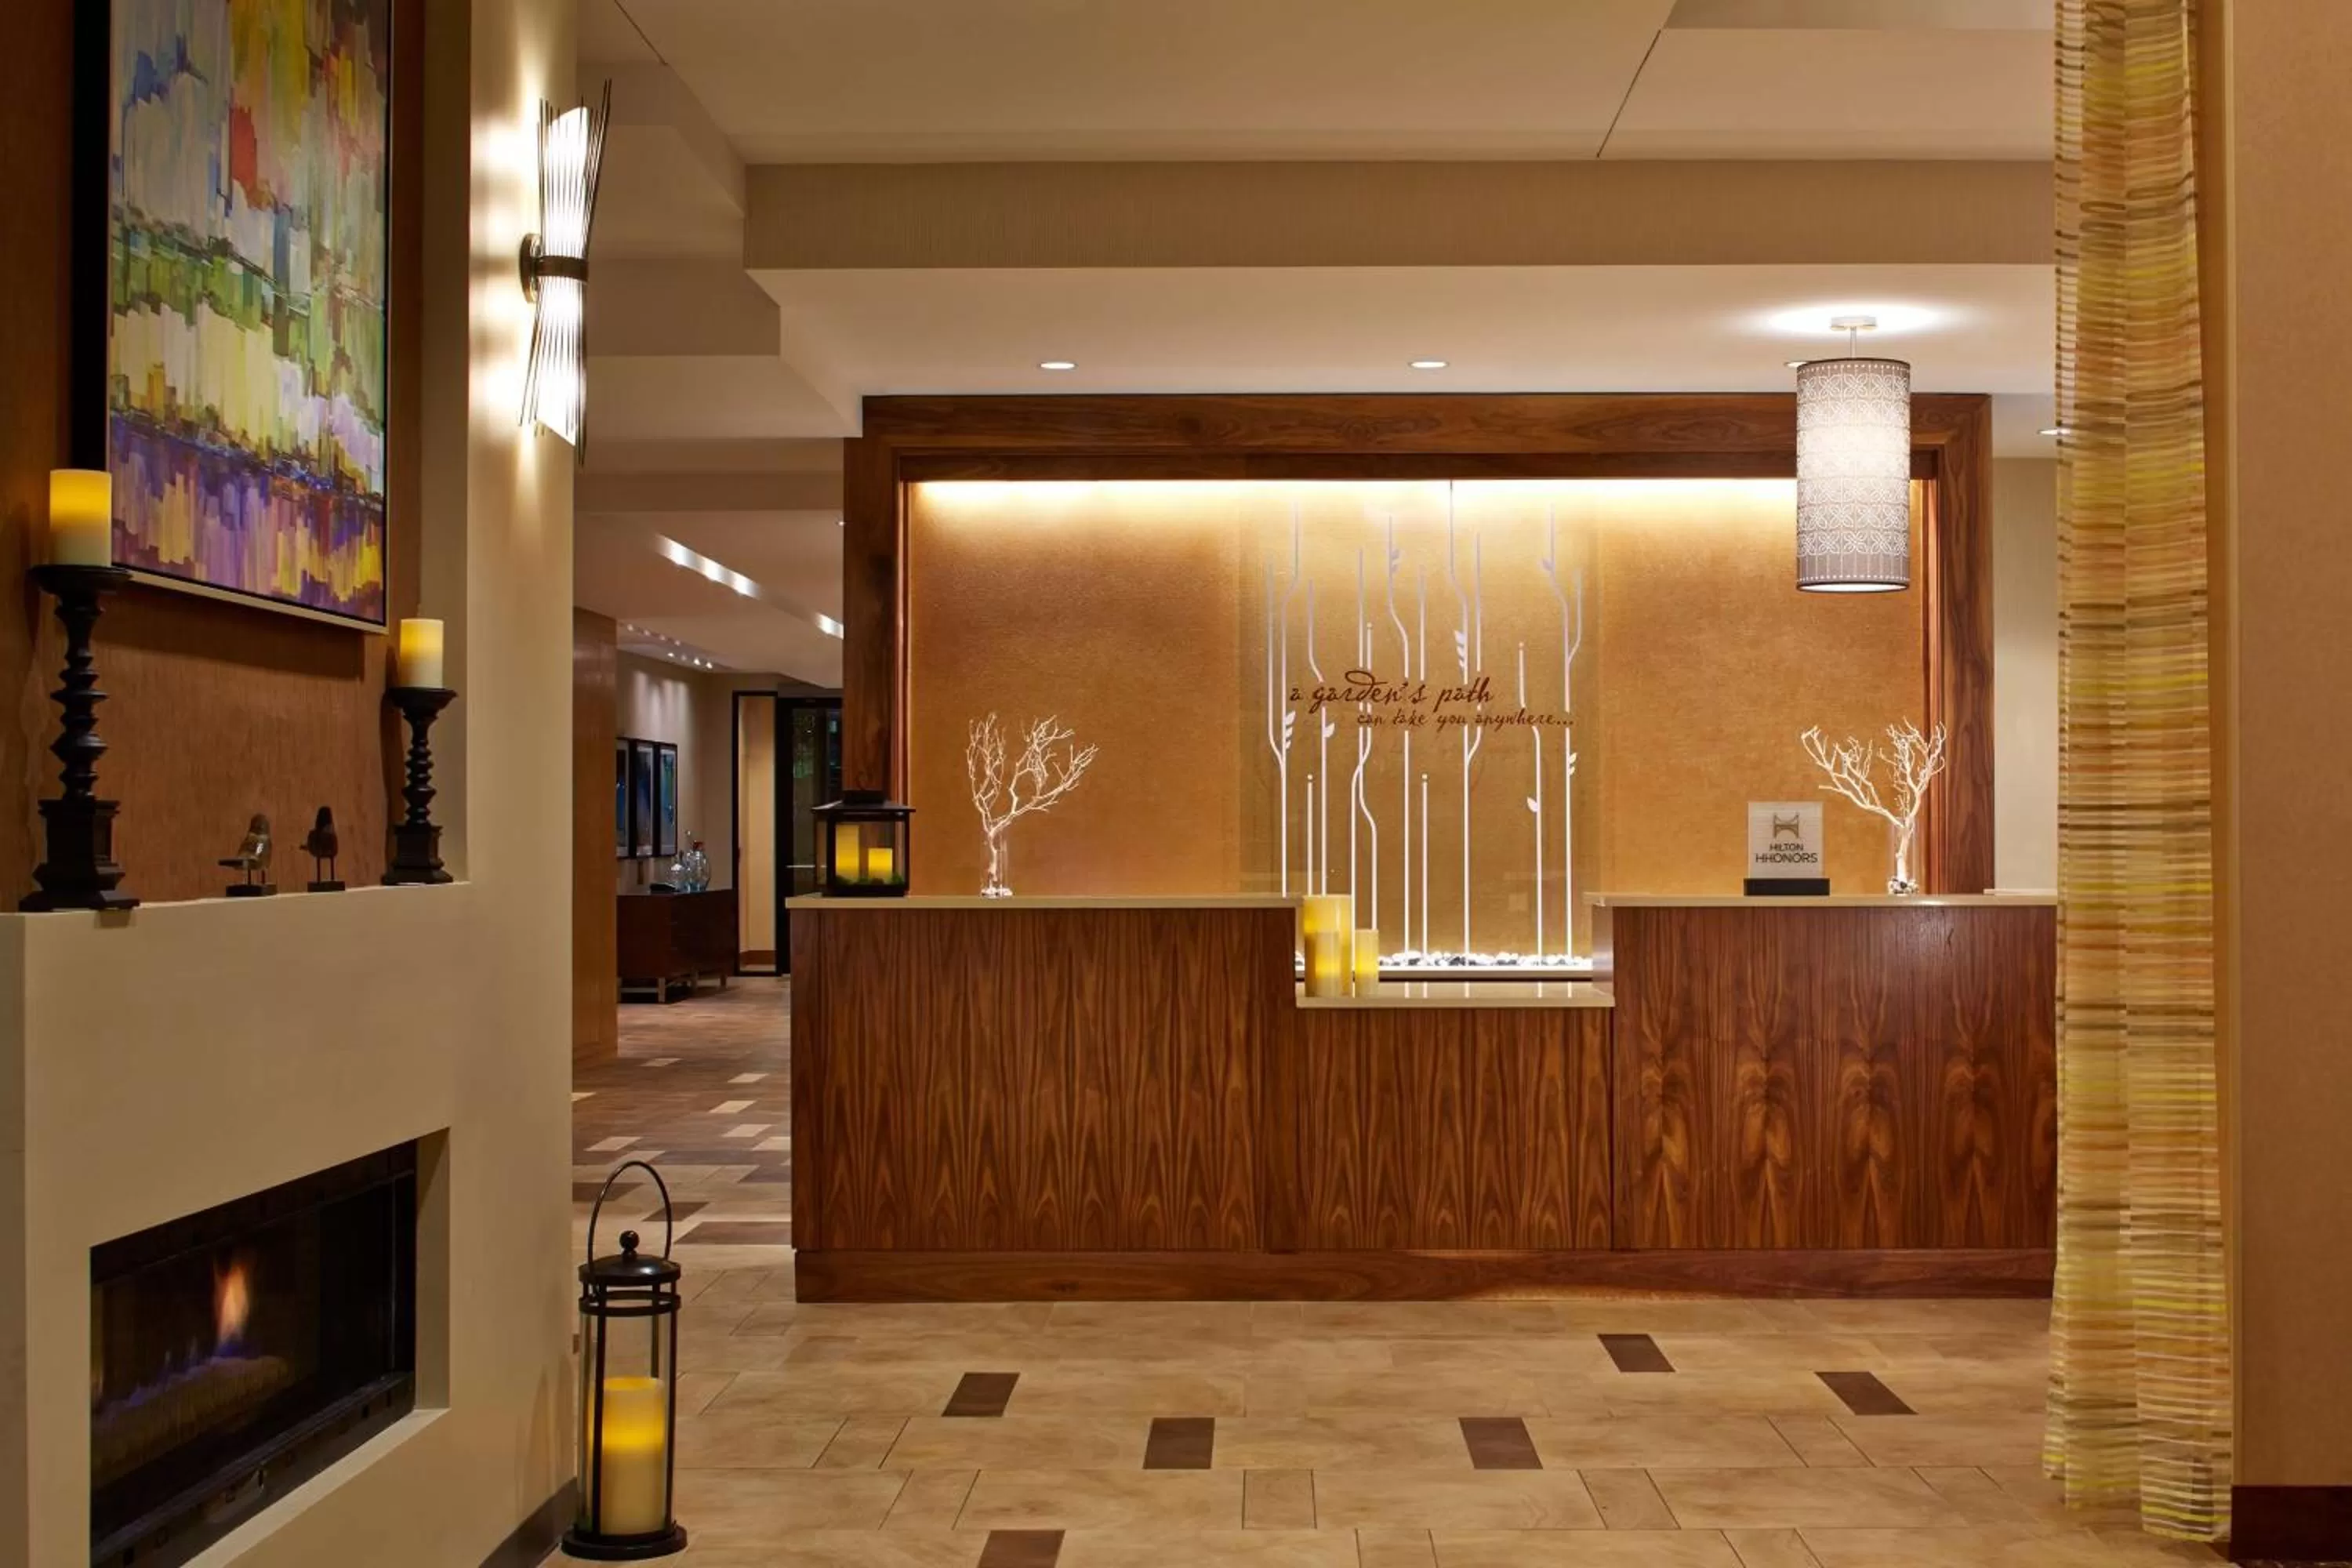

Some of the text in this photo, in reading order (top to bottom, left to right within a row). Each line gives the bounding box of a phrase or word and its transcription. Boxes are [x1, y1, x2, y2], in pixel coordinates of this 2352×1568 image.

[1290, 670, 1494, 714] a garden's path
[1357, 713, 1384, 728] can
[1392, 708, 1428, 728] take
[1436, 713, 1468, 733] you
[1769, 843, 1804, 851] HILTON
[1755, 852, 1818, 863] HHONORS
